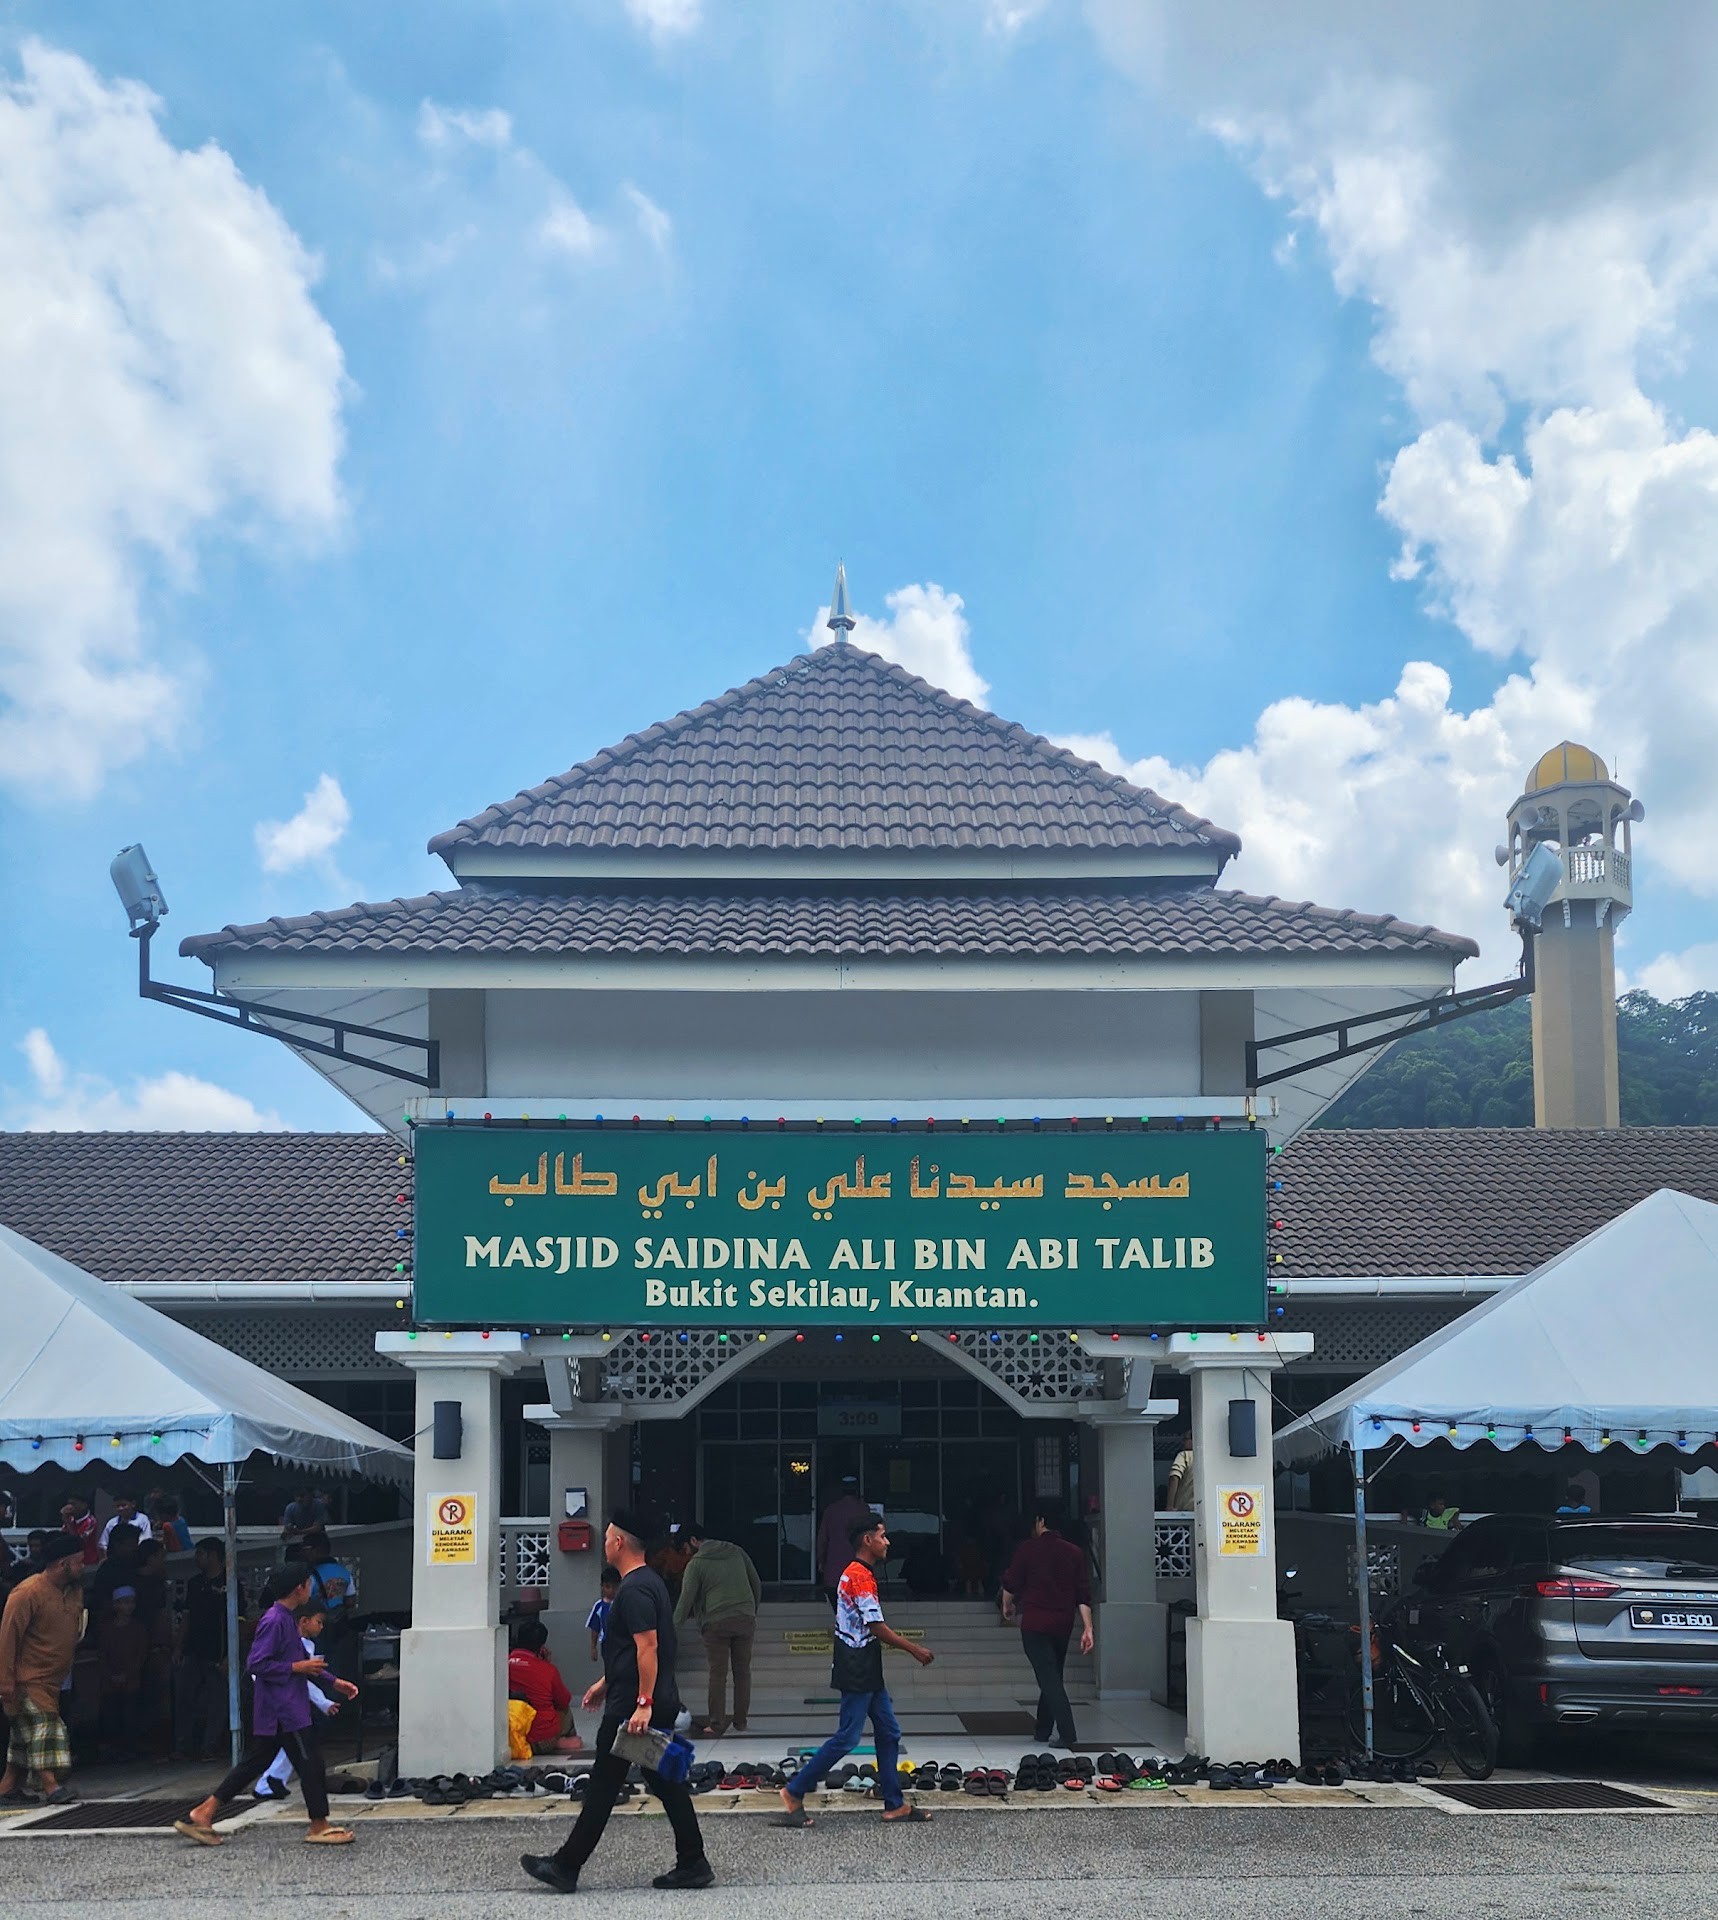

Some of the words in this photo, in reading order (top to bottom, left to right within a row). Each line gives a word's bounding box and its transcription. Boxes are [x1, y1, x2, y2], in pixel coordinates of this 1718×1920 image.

[488, 1151, 618, 1207] طالب
[638, 1153, 718, 1220] ابي
[737, 1170, 786, 1211] بن
[807, 1154, 892, 1221] علي
[909, 1154, 1044, 1211] سيدنا
[1064, 1172, 1190, 1211] مسجد
[463, 1235, 619, 1274] MASJID
[634, 1236, 812, 1270] SAIDINA
[828, 1238, 896, 1270] ALI
[914, 1238, 986, 1270] BIN
[1006, 1238, 1079, 1270] ABI
[1094, 1237, 1215, 1269] TALIB
[645, 1278, 738, 1308] Bukit
[749, 1278, 881, 1312] Sekilau,
[890, 1280, 1039, 1308] Kuantan.
[1661, 1613, 1714, 1626] CEC1600
